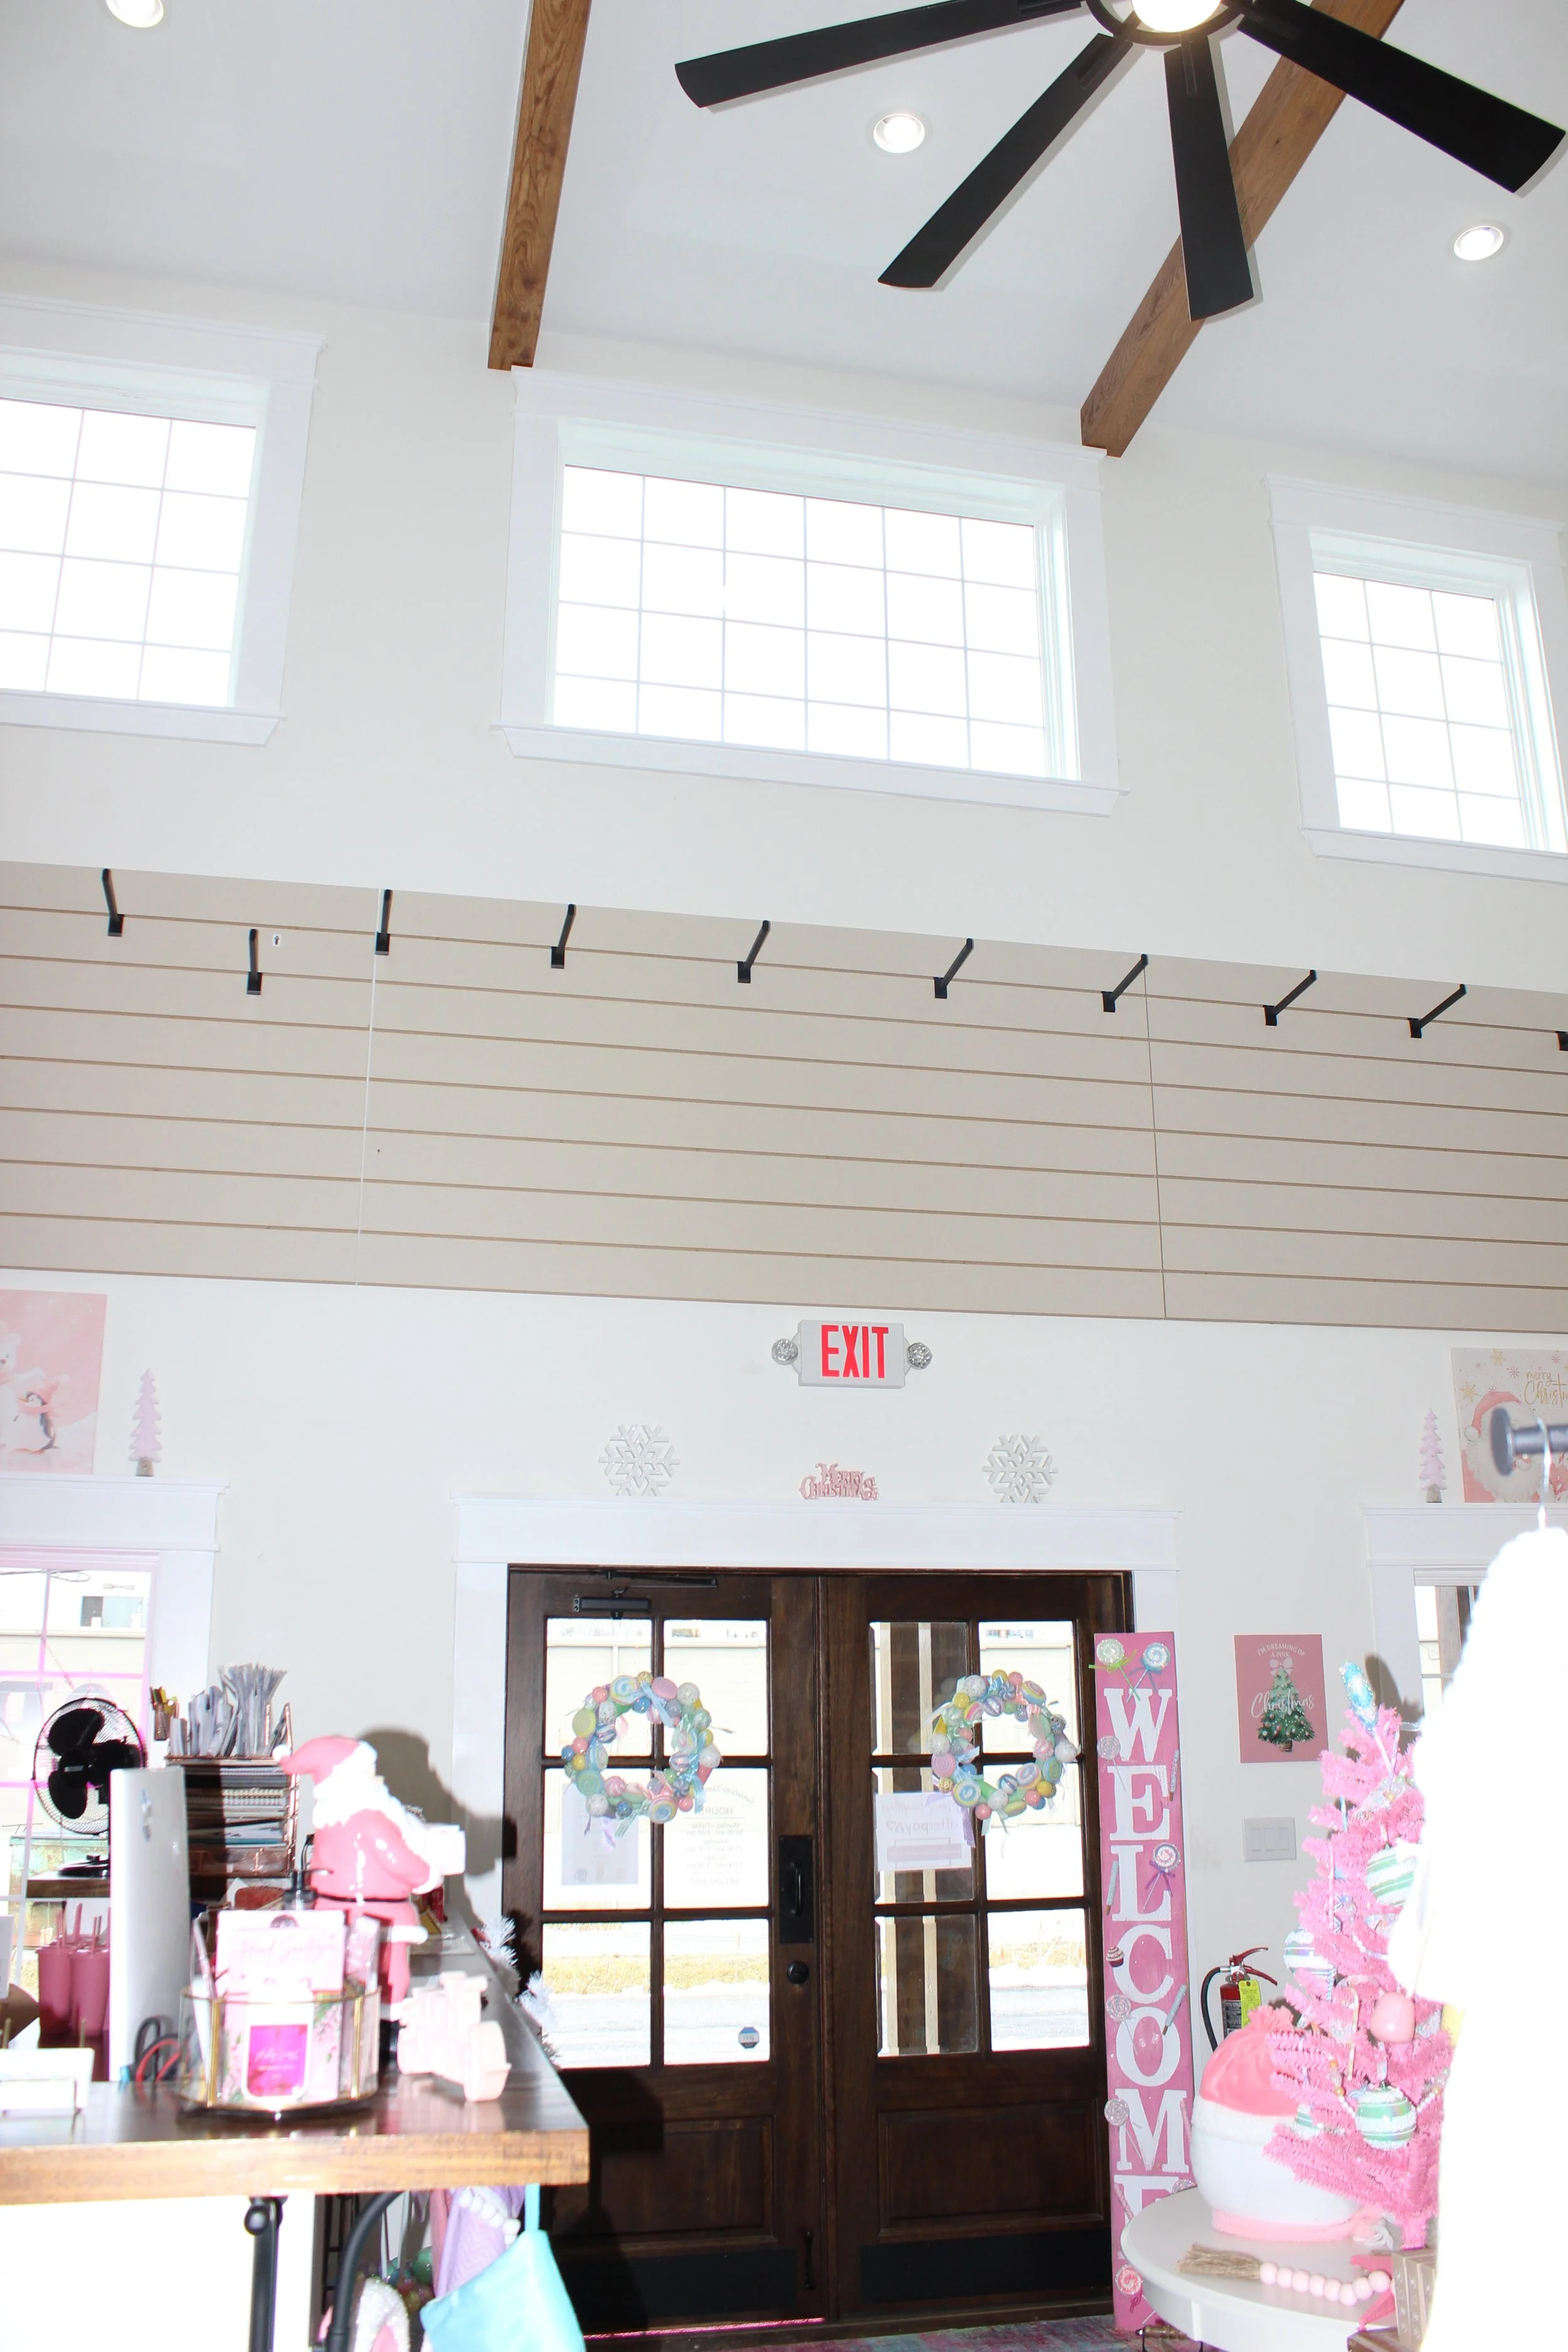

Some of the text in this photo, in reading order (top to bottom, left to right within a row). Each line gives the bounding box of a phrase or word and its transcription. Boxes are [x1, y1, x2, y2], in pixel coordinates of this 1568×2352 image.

[821, 1325, 889, 1379] EXIT
[1526, 1372, 1555, 1387] merry
[1257, 1643, 1306, 1657] I'M DREAMING OF
[1251, 1690, 1315, 1718] Christmas
